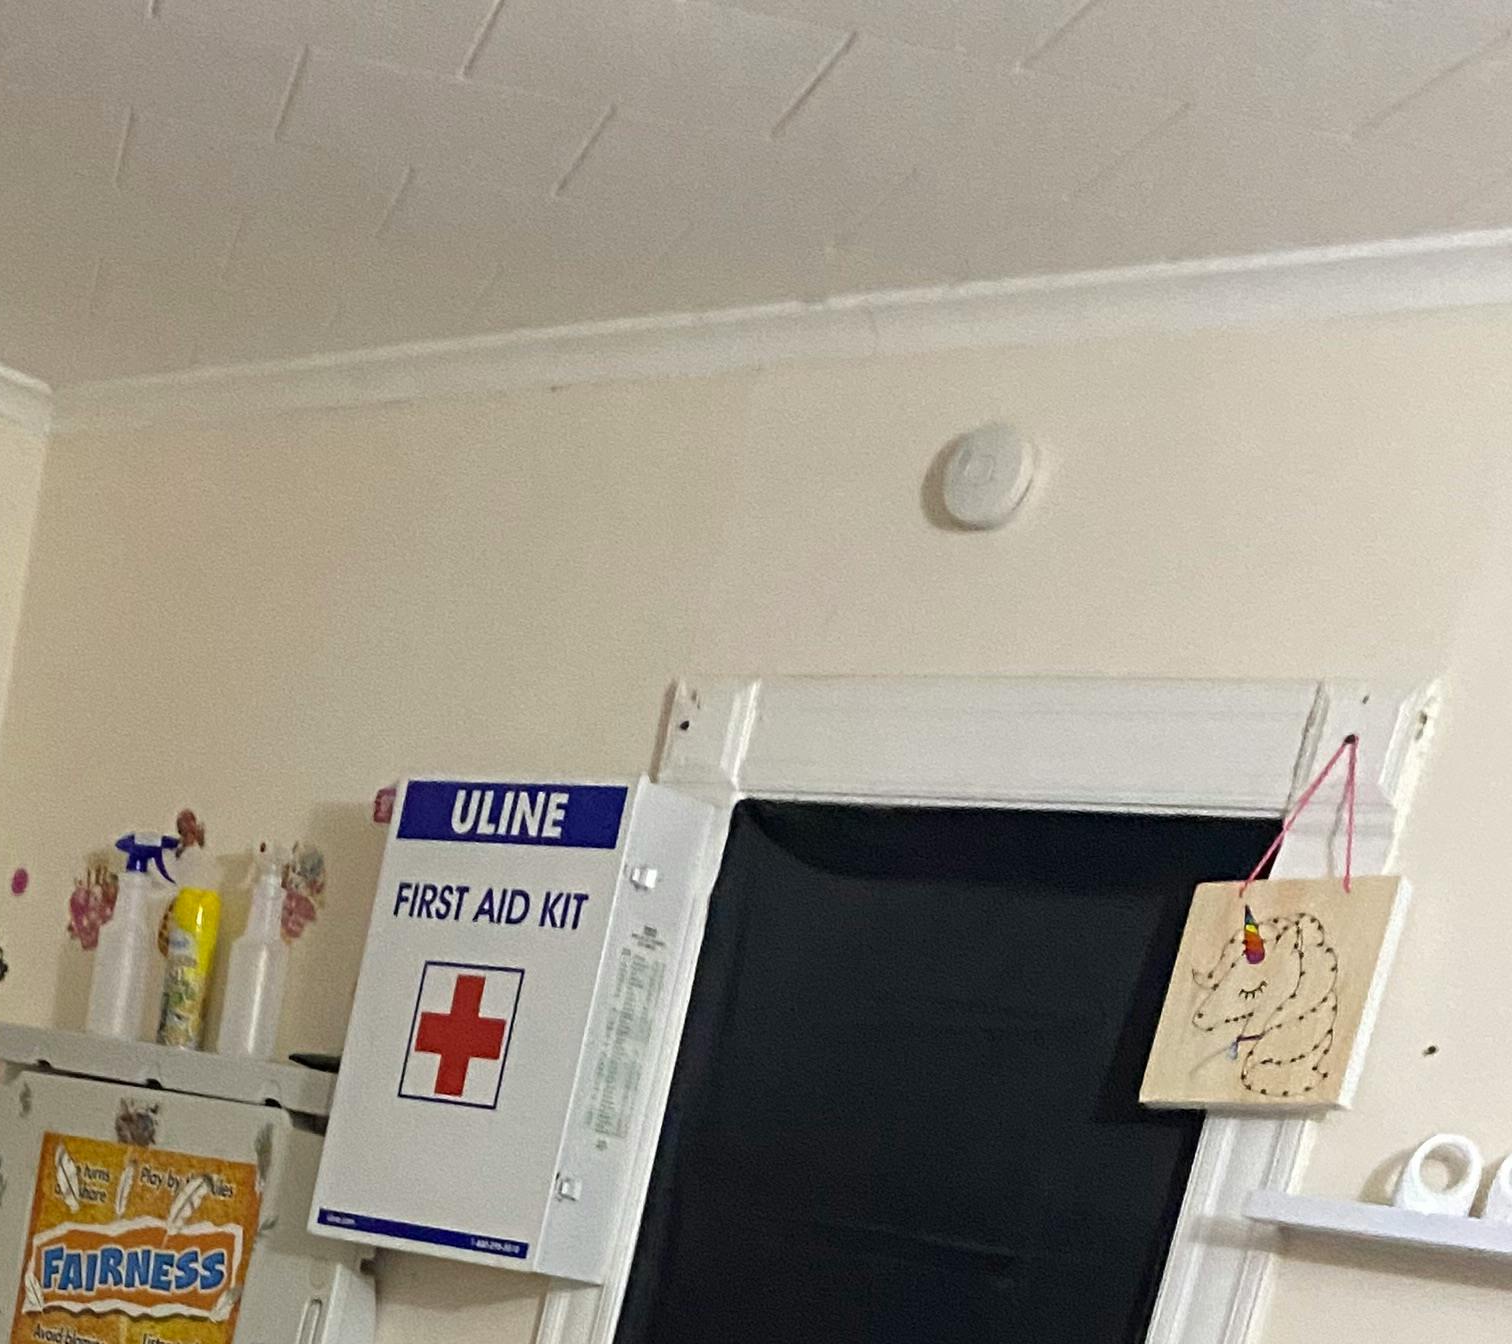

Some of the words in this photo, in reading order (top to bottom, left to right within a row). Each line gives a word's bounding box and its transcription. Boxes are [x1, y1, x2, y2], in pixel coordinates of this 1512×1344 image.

[451, 790, 569, 840] ULINE
[393, 882, 470, 921] FIRST
[473, 887, 530, 925] AID
[539, 891, 589, 930] KIT
[140, 1166, 162, 1190] Play
[168, 1169, 180, 1194] by
[44, 1247, 225, 1292] FAIRNESS
[33, 1324, 63, 1343] Avoid
